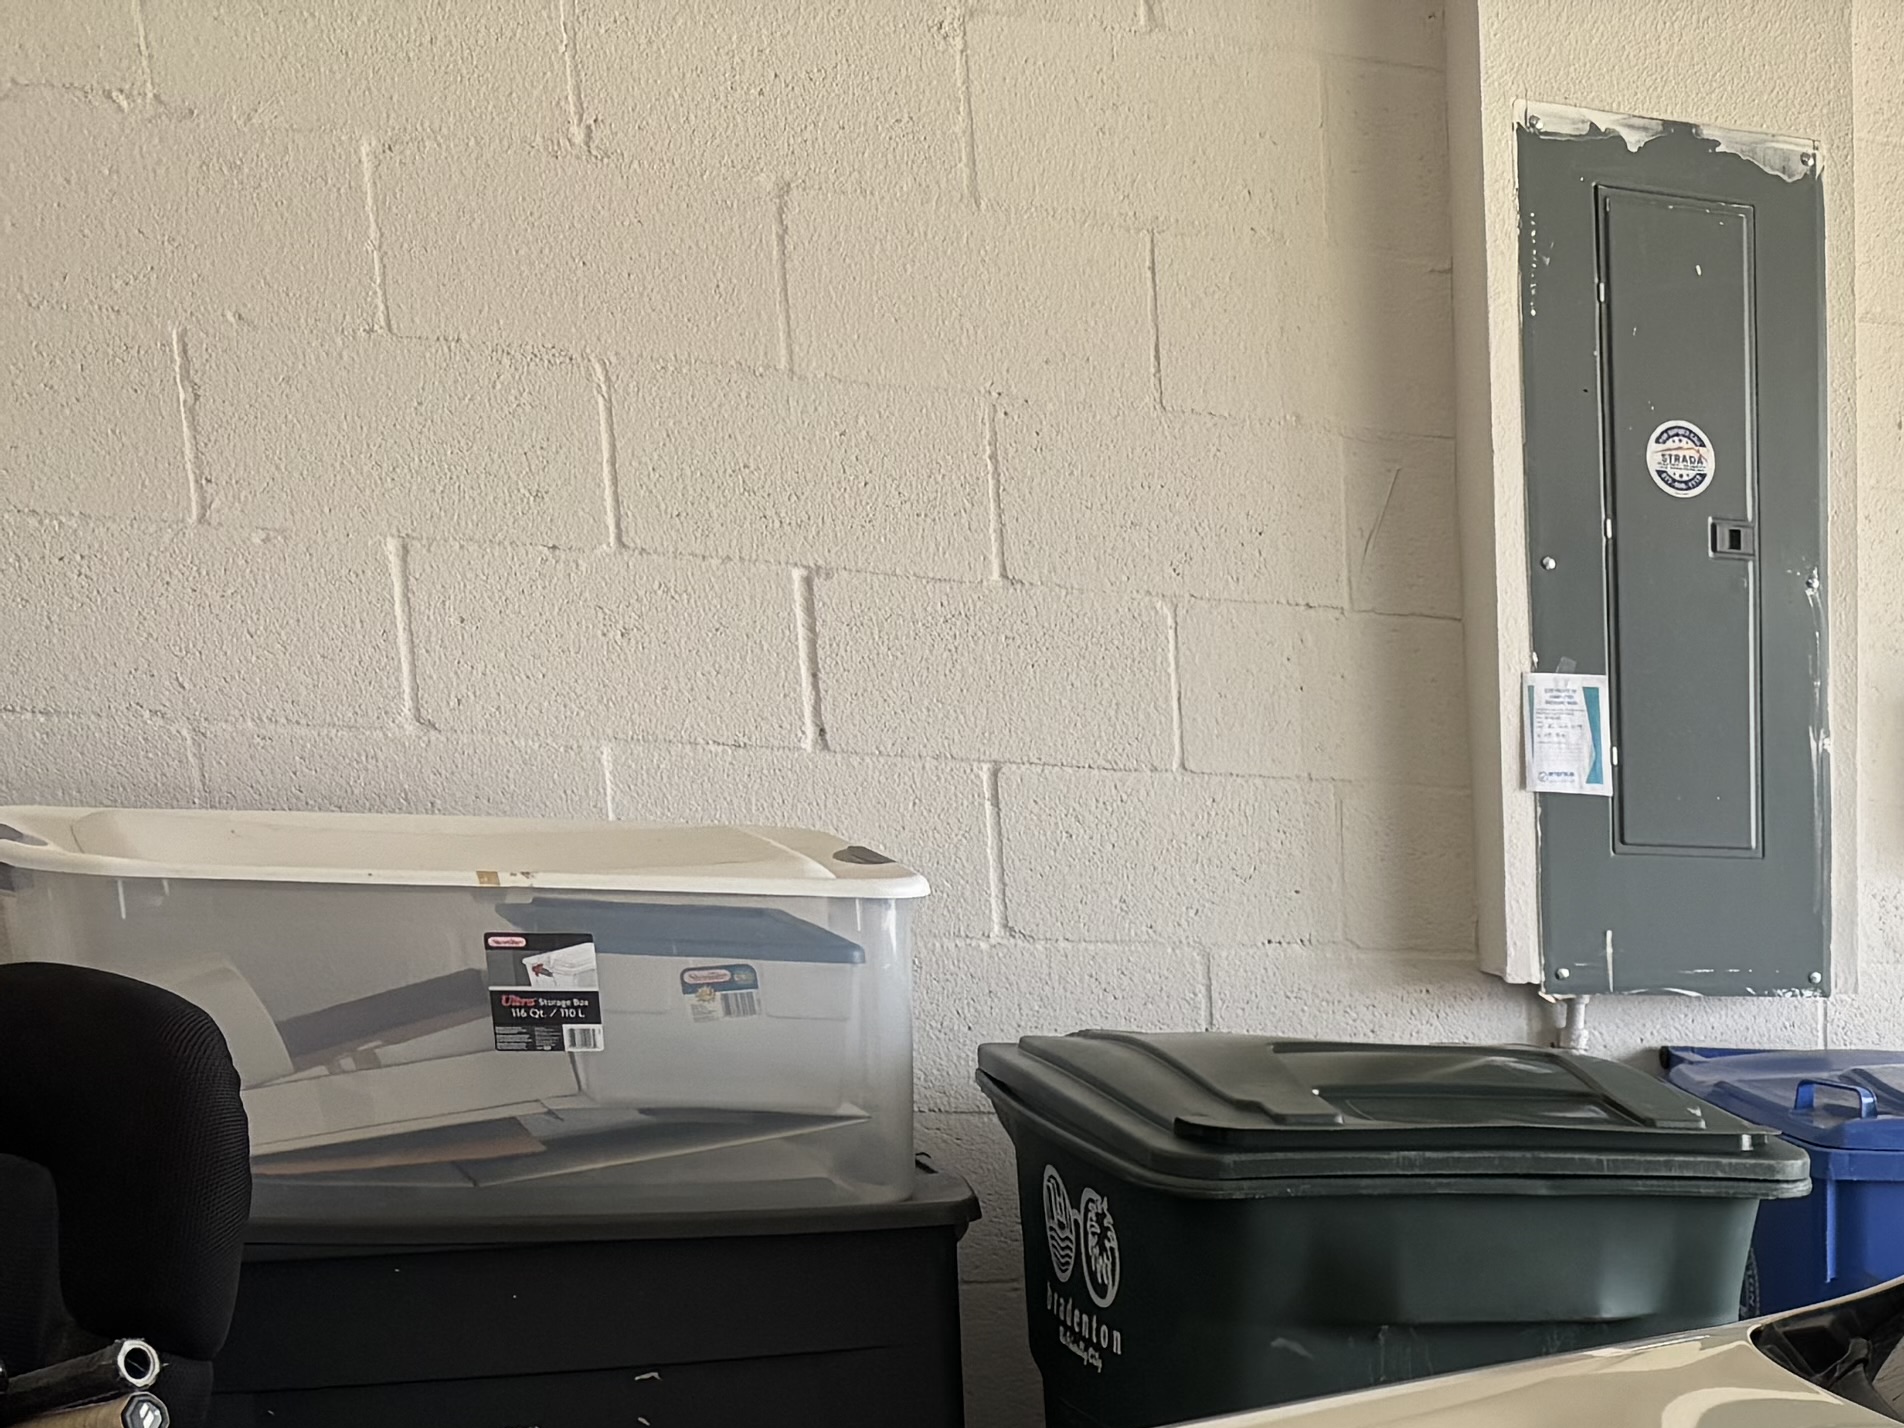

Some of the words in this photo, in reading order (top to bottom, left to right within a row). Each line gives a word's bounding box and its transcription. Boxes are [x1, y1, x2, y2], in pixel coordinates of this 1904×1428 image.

[1661, 453, 1704, 466] STRADA
[538, 998, 572, 1009] Storage
[573, 998, 589, 1007] Box
[511, 1008, 527, 1018] 116
[560, 1009, 576, 1018] 110
[578, 1009, 585, 1018] L
